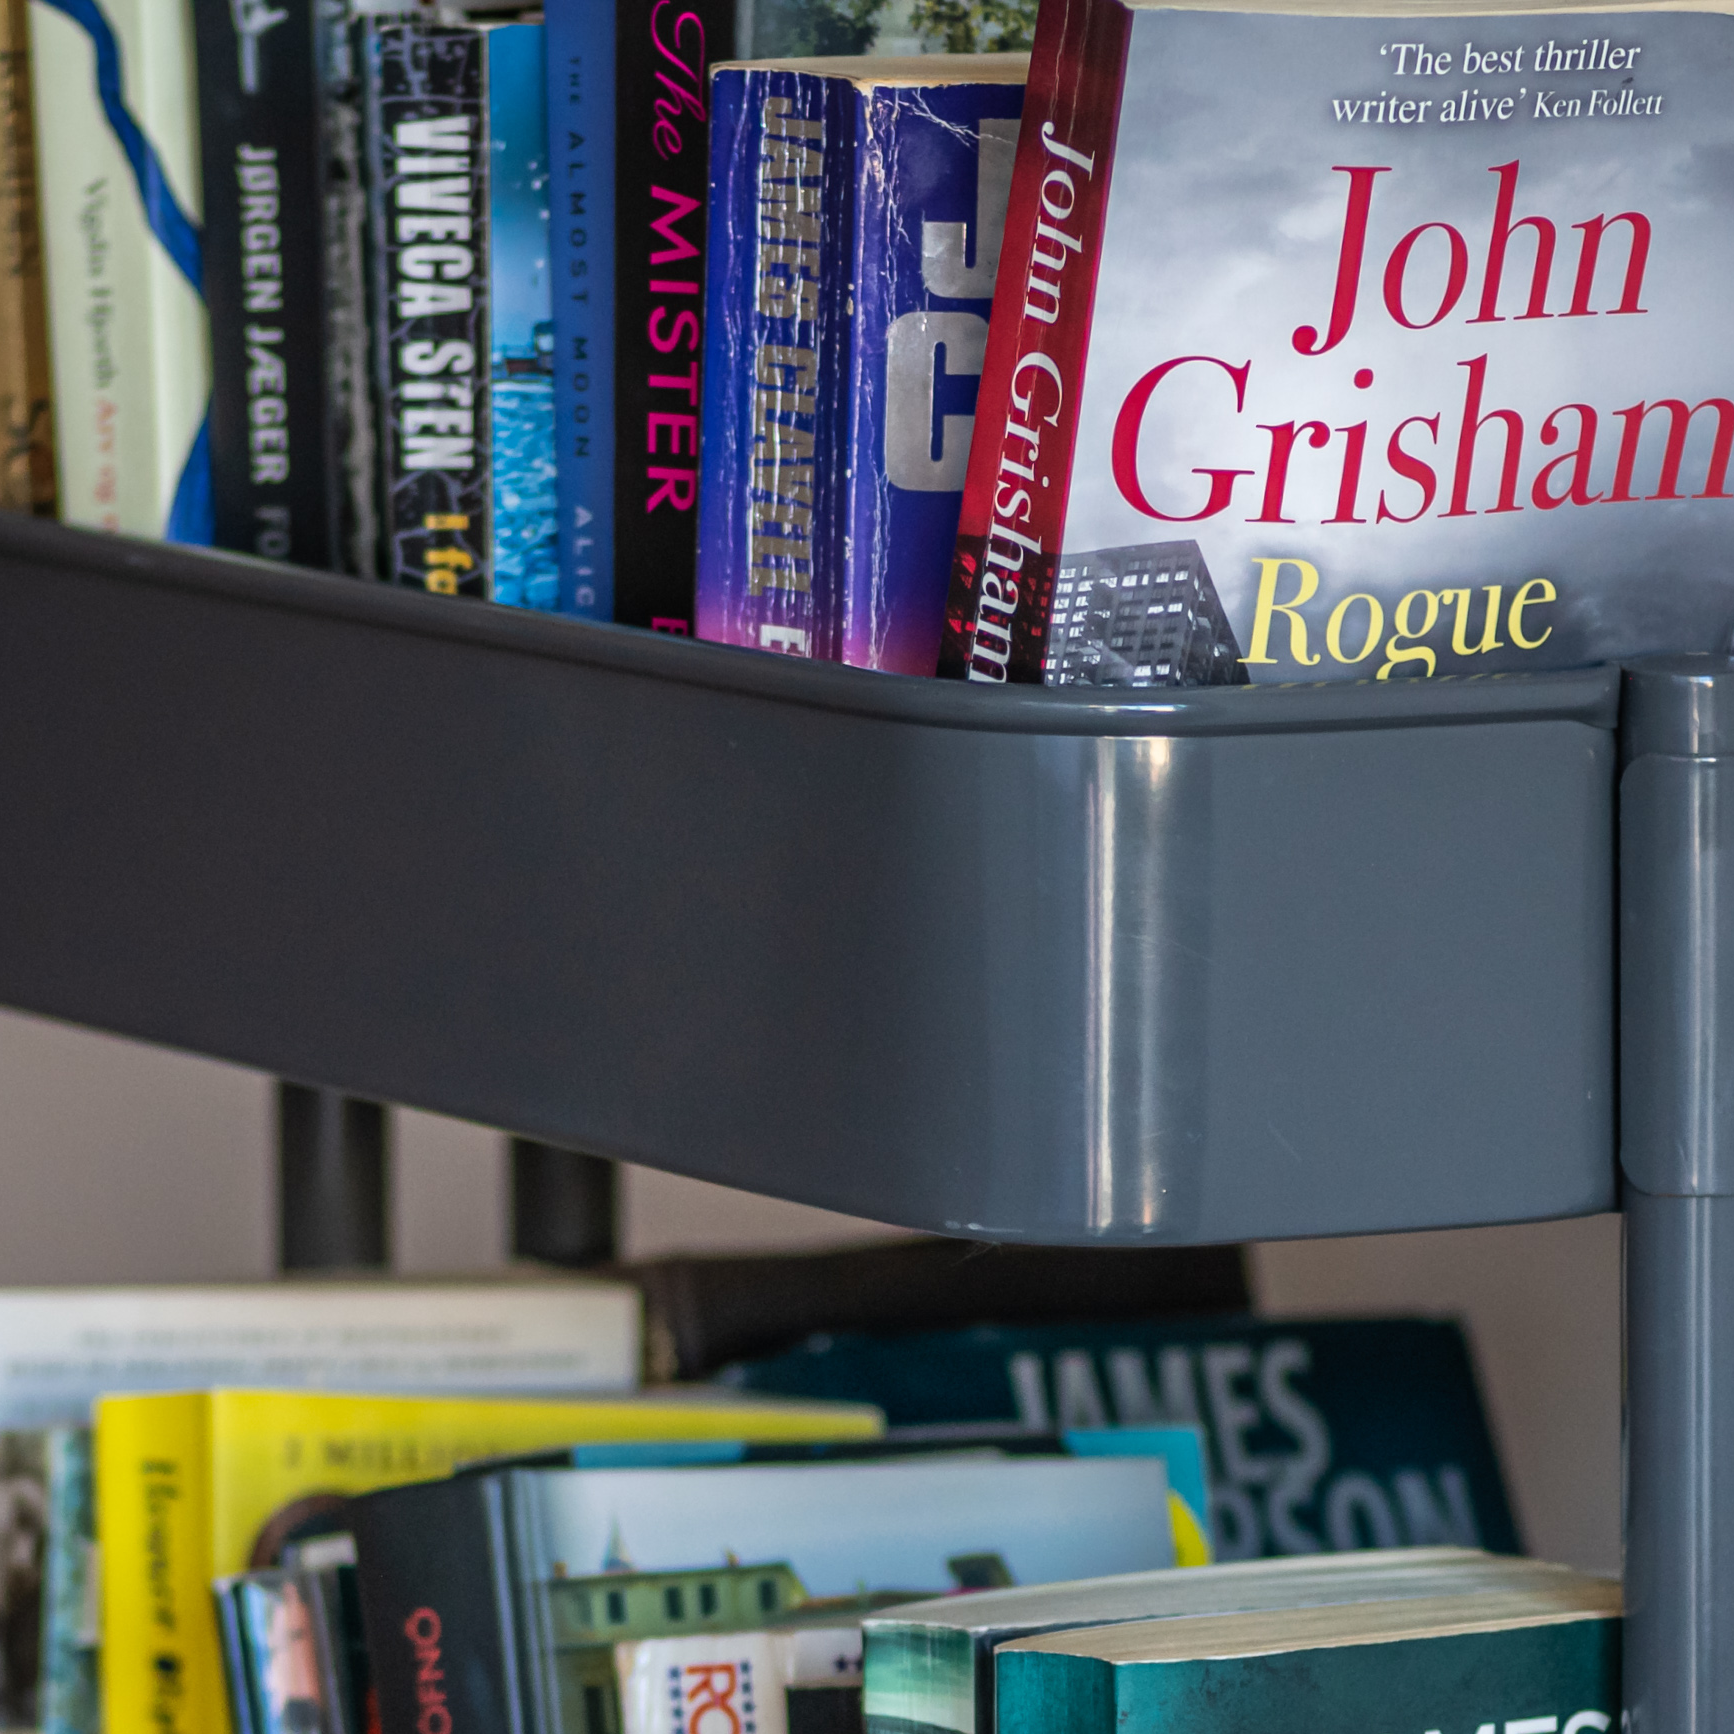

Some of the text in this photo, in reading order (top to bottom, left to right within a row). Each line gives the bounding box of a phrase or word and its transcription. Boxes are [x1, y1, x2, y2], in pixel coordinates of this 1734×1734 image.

[1332, 90, 1433, 124] writer
[1532, 91, 1582, 119] Ken
[1586, 88, 1665, 118] Follett
[1462, 42, 1526, 74] best
[1533, 38, 1642, 72] thriller
[234, 143, 283, 312] JØRGEN
[393, 115, 476, 471] VIVECA STEN
[566, 130, 589, 307] ALMOST
[646, 0, 707, 513] The MISTER
[1291, 159, 1654, 356] John
[243, 325, 289, 484] JÆGER
[571, 337, 592, 460] MOON
[748, 96, 825, 598] JAMES CLAVELL
[969, 121, 1097, 685] John Grisham
[1237, 556, 1559, 681] Rogue
